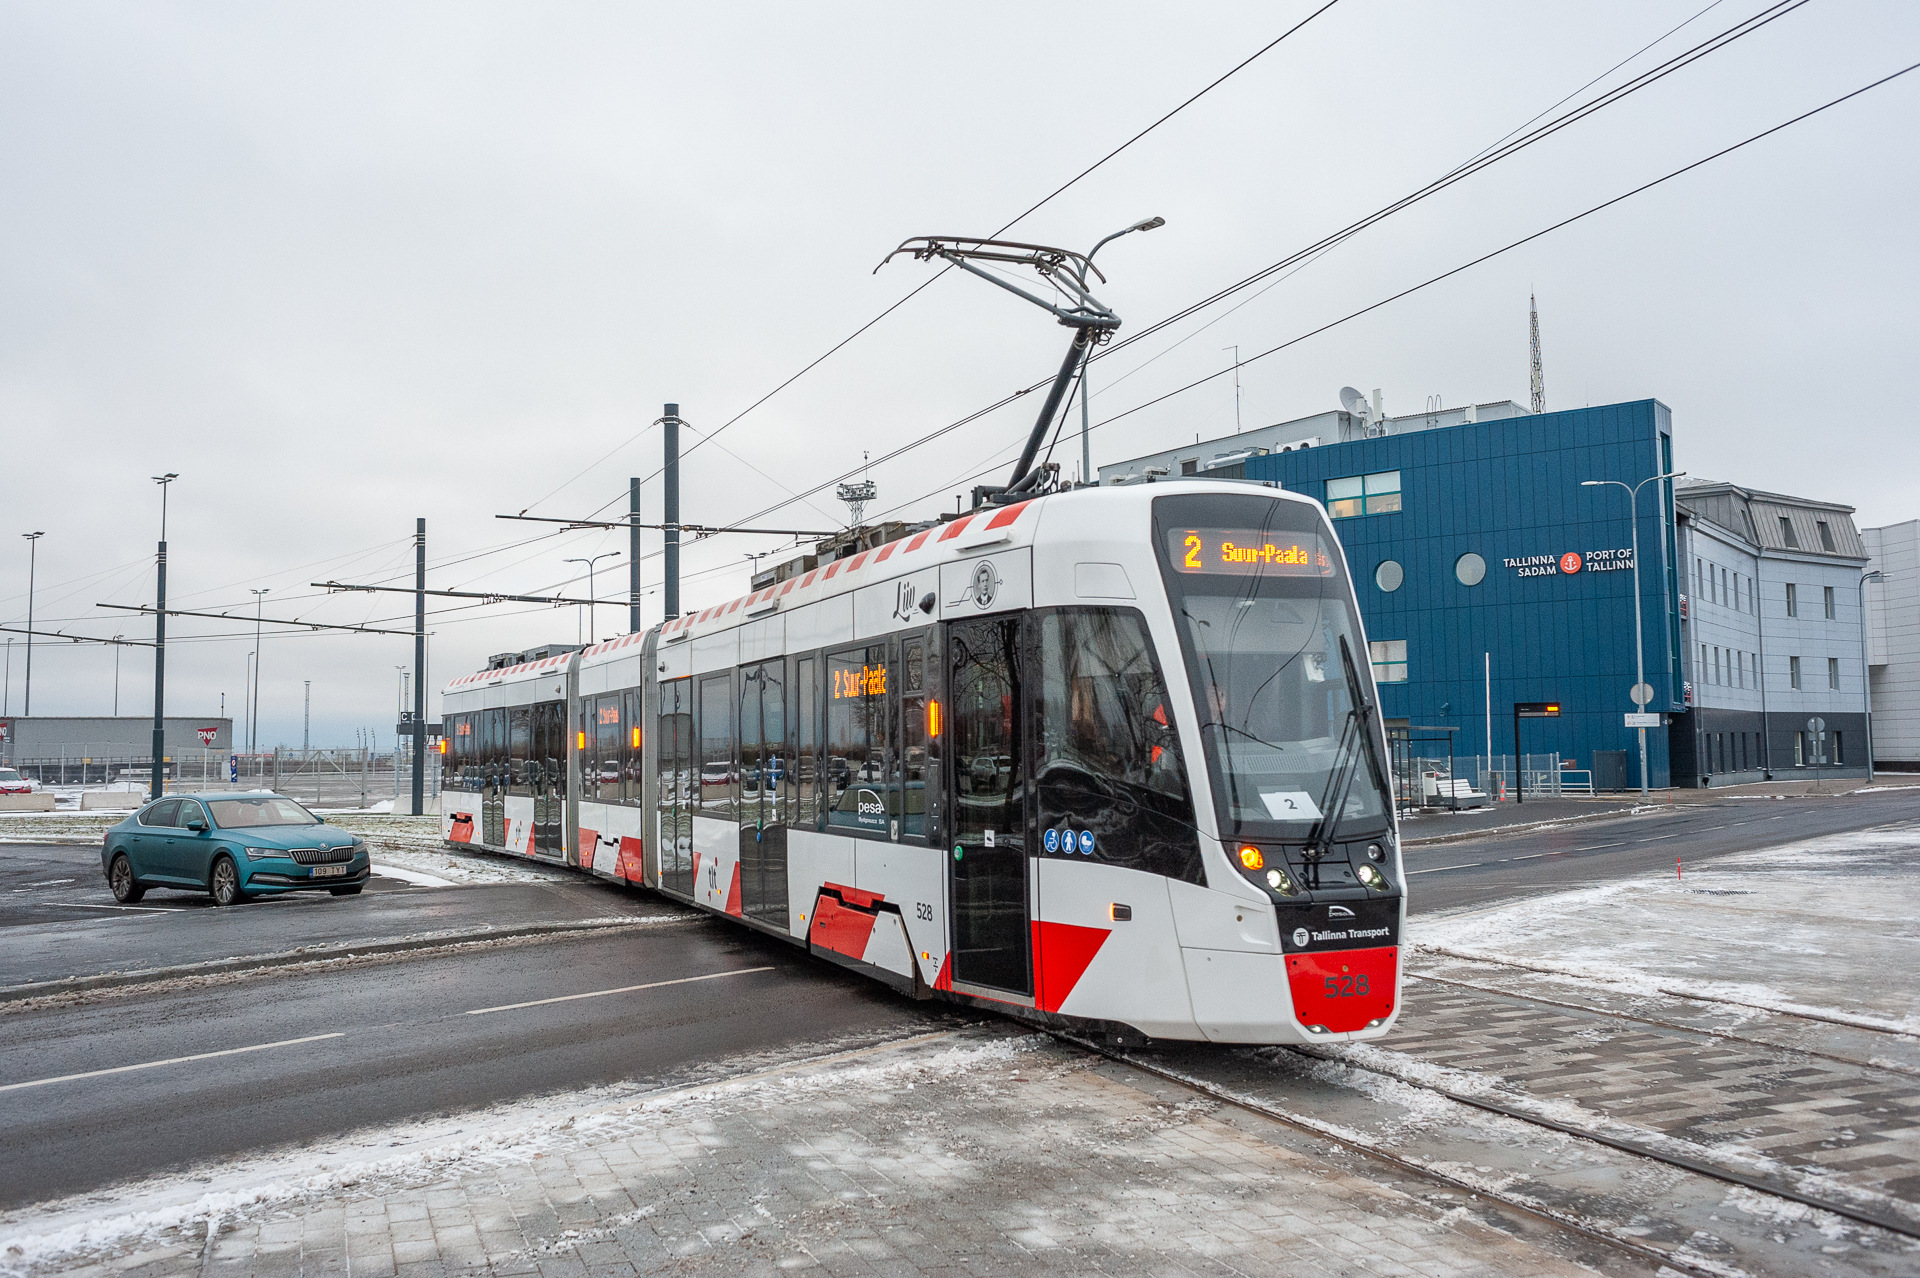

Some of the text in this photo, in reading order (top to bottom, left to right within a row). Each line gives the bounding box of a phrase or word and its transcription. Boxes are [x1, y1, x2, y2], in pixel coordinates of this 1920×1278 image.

[1185, 535, 1202, 568] 2
[1221, 542, 1308, 565] Suur-Paala
[1585, 548, 1633, 560] PORT OF
[1503, 555, 1556, 568] TALLINNA
[1585, 560, 1634, 572] TALLINN
[1518, 566, 1557, 577] SADAM
[893, 581, 915, 622] Liiv
[834, 670, 840, 699] 2
[197, 731, 217, 740] PNO
[858, 802, 881, 815] pesa
[1284, 799, 1298, 810] 2
[917, 902, 933, 922] 528
[1311, 927, 1390, 941] Tallinna Transport
[1324, 974, 1370, 998] 528
